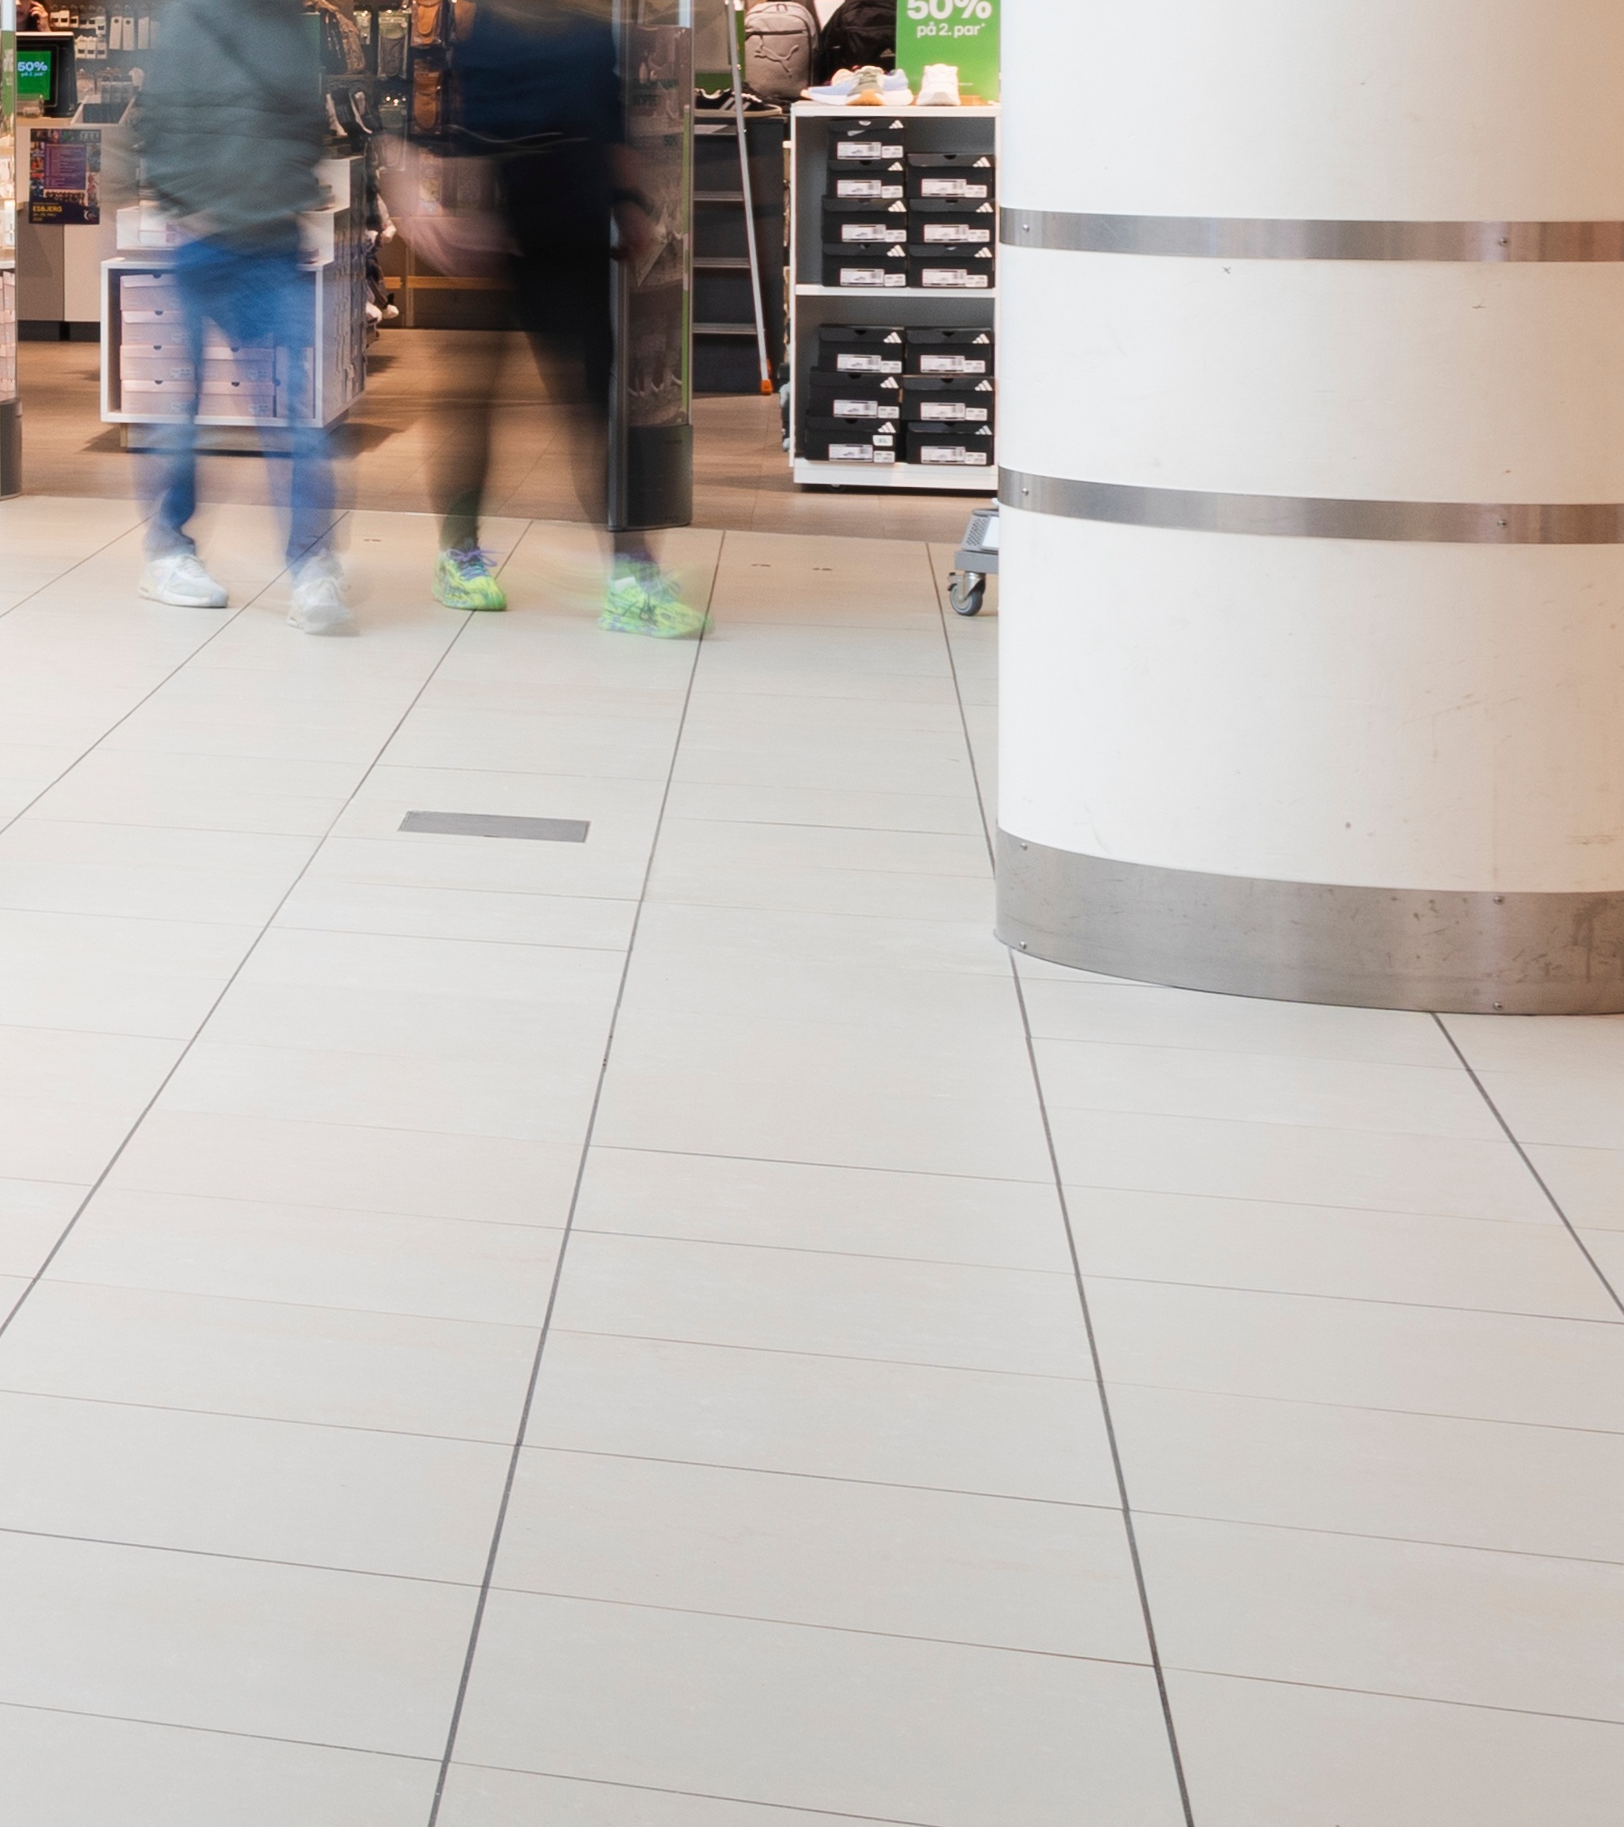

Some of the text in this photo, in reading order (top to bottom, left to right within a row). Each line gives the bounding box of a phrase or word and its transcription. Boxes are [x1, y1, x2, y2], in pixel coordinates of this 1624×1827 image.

[916, 21, 937, 39] på
[939, 23, 952, 36] 2.
[17, 61, 48, 72] 50%
